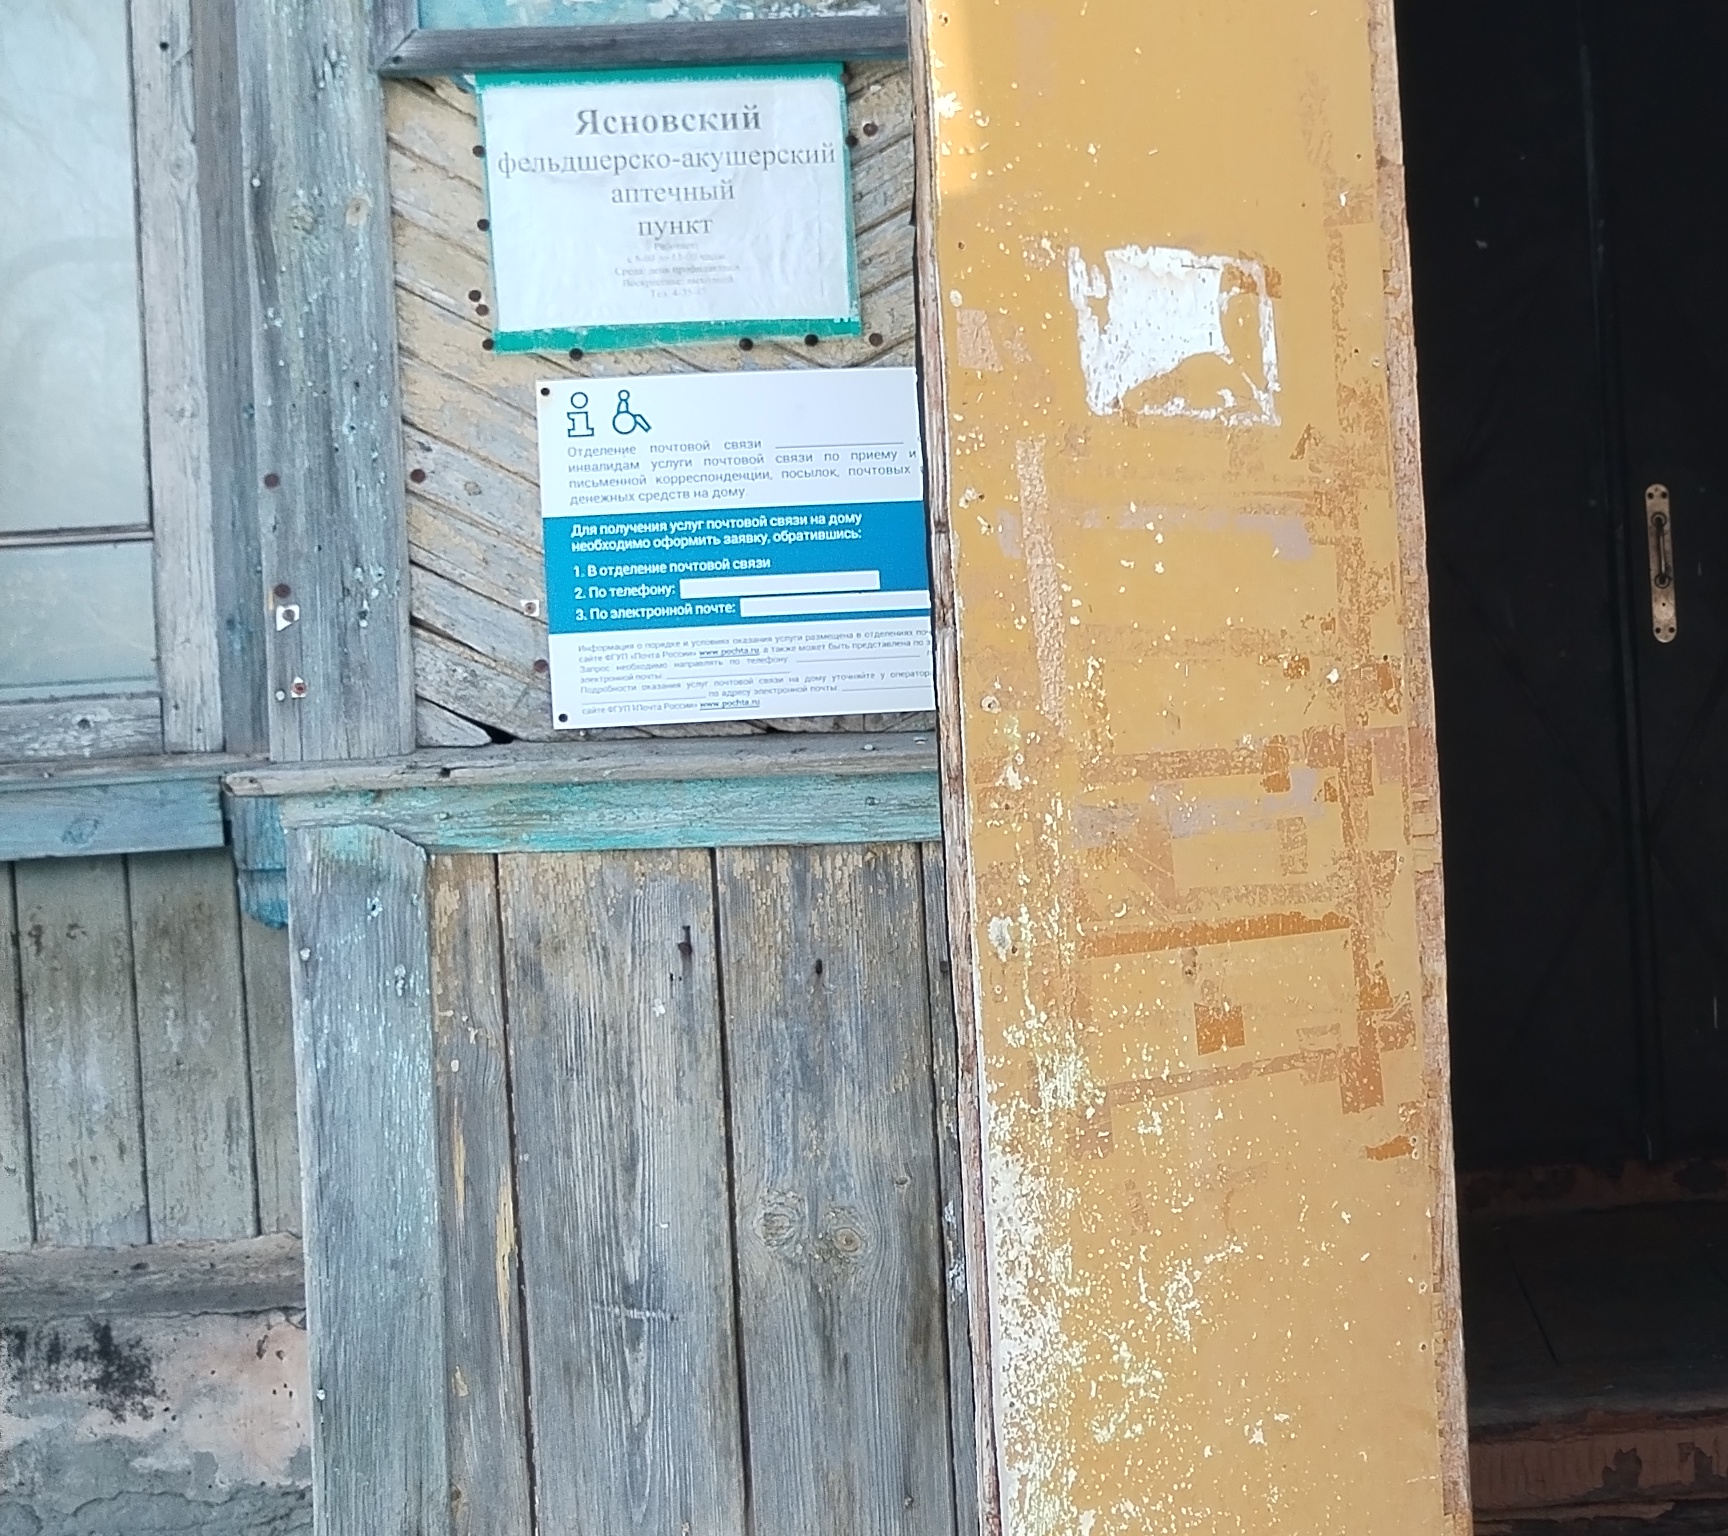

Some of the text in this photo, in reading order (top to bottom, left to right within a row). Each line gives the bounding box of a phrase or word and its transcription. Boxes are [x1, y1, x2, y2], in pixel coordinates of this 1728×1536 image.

[575, 105, 762, 135] Ясновский
[498, 142, 836, 178] фельдшерско-акушерский
[611, 179, 734, 204] аптечный
[638, 219, 713, 240] пункт
[567, 439, 761, 458] Отделение почтовой связи
[568, 450, 917, 473] инвалидам услуги почтовой связи по приему и
[569, 475, 647, 488] письменной
[655, 470, 773, 486] корреспонденции,
[781, 468, 840, 479] посылок,
[848, 464, 911, 476] почтовых
[569, 493, 635, 506] денежных
[638, 489, 690, 503] средств
[694, 489, 709, 498] на
[571, 513, 862, 538] Для получения услуг почтовой связи на дому
[571, 529, 862, 552] необходимо оформить заявку, обратившись:
[573, 558, 771, 578] 1. В отделение почтовой связи
[574, 583, 676, 600] 2. По телефону:
[575, 603, 736, 621] 3. По электронной почте:
